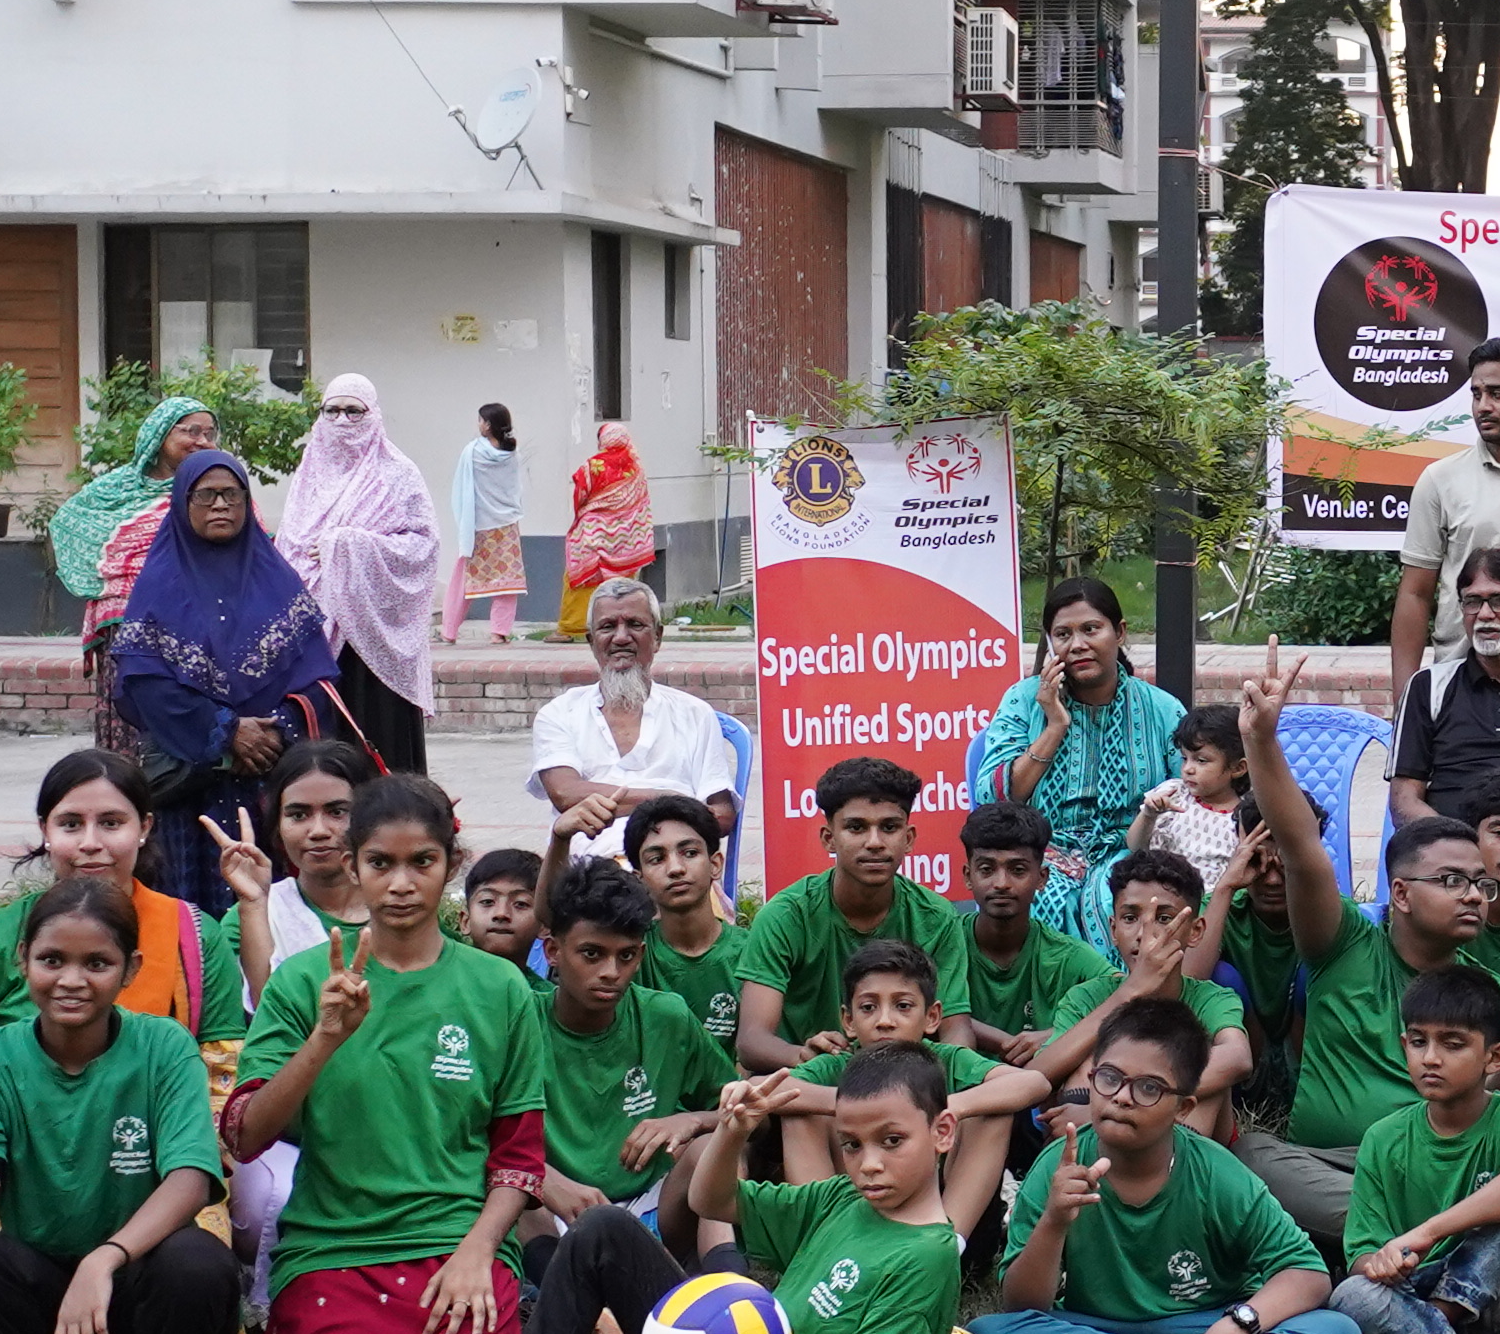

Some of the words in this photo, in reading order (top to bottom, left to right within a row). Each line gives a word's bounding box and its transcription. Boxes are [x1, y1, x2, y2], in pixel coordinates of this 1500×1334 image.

[1356, 326, 1446, 343] Special
[1348, 345, 1453, 363] Olympics
[1353, 367, 1449, 386] Bangladesh
[792, 439, 844, 458] LIONS
[808, 463, 832, 493] L
[794, 503, 846, 519] INTERNATIONAL
[901, 495, 990, 512] Special
[1303, 494, 1374, 518] Venue:
[1381, 495, 1409, 519] Ce
[776, 512, 865, 540] BANGLADESH
[895, 513, 999, 530] Olympics
[771, 519, 800, 545] LIONS
[804, 518, 871, 550] FOUNDATION
[900, 530, 995, 549] Bangladesh
[761, 633, 864, 686] Special
[872, 628, 1007, 682] Olympics
[782, 702, 889, 747] Unified
[896, 703, 990, 752] Sports
